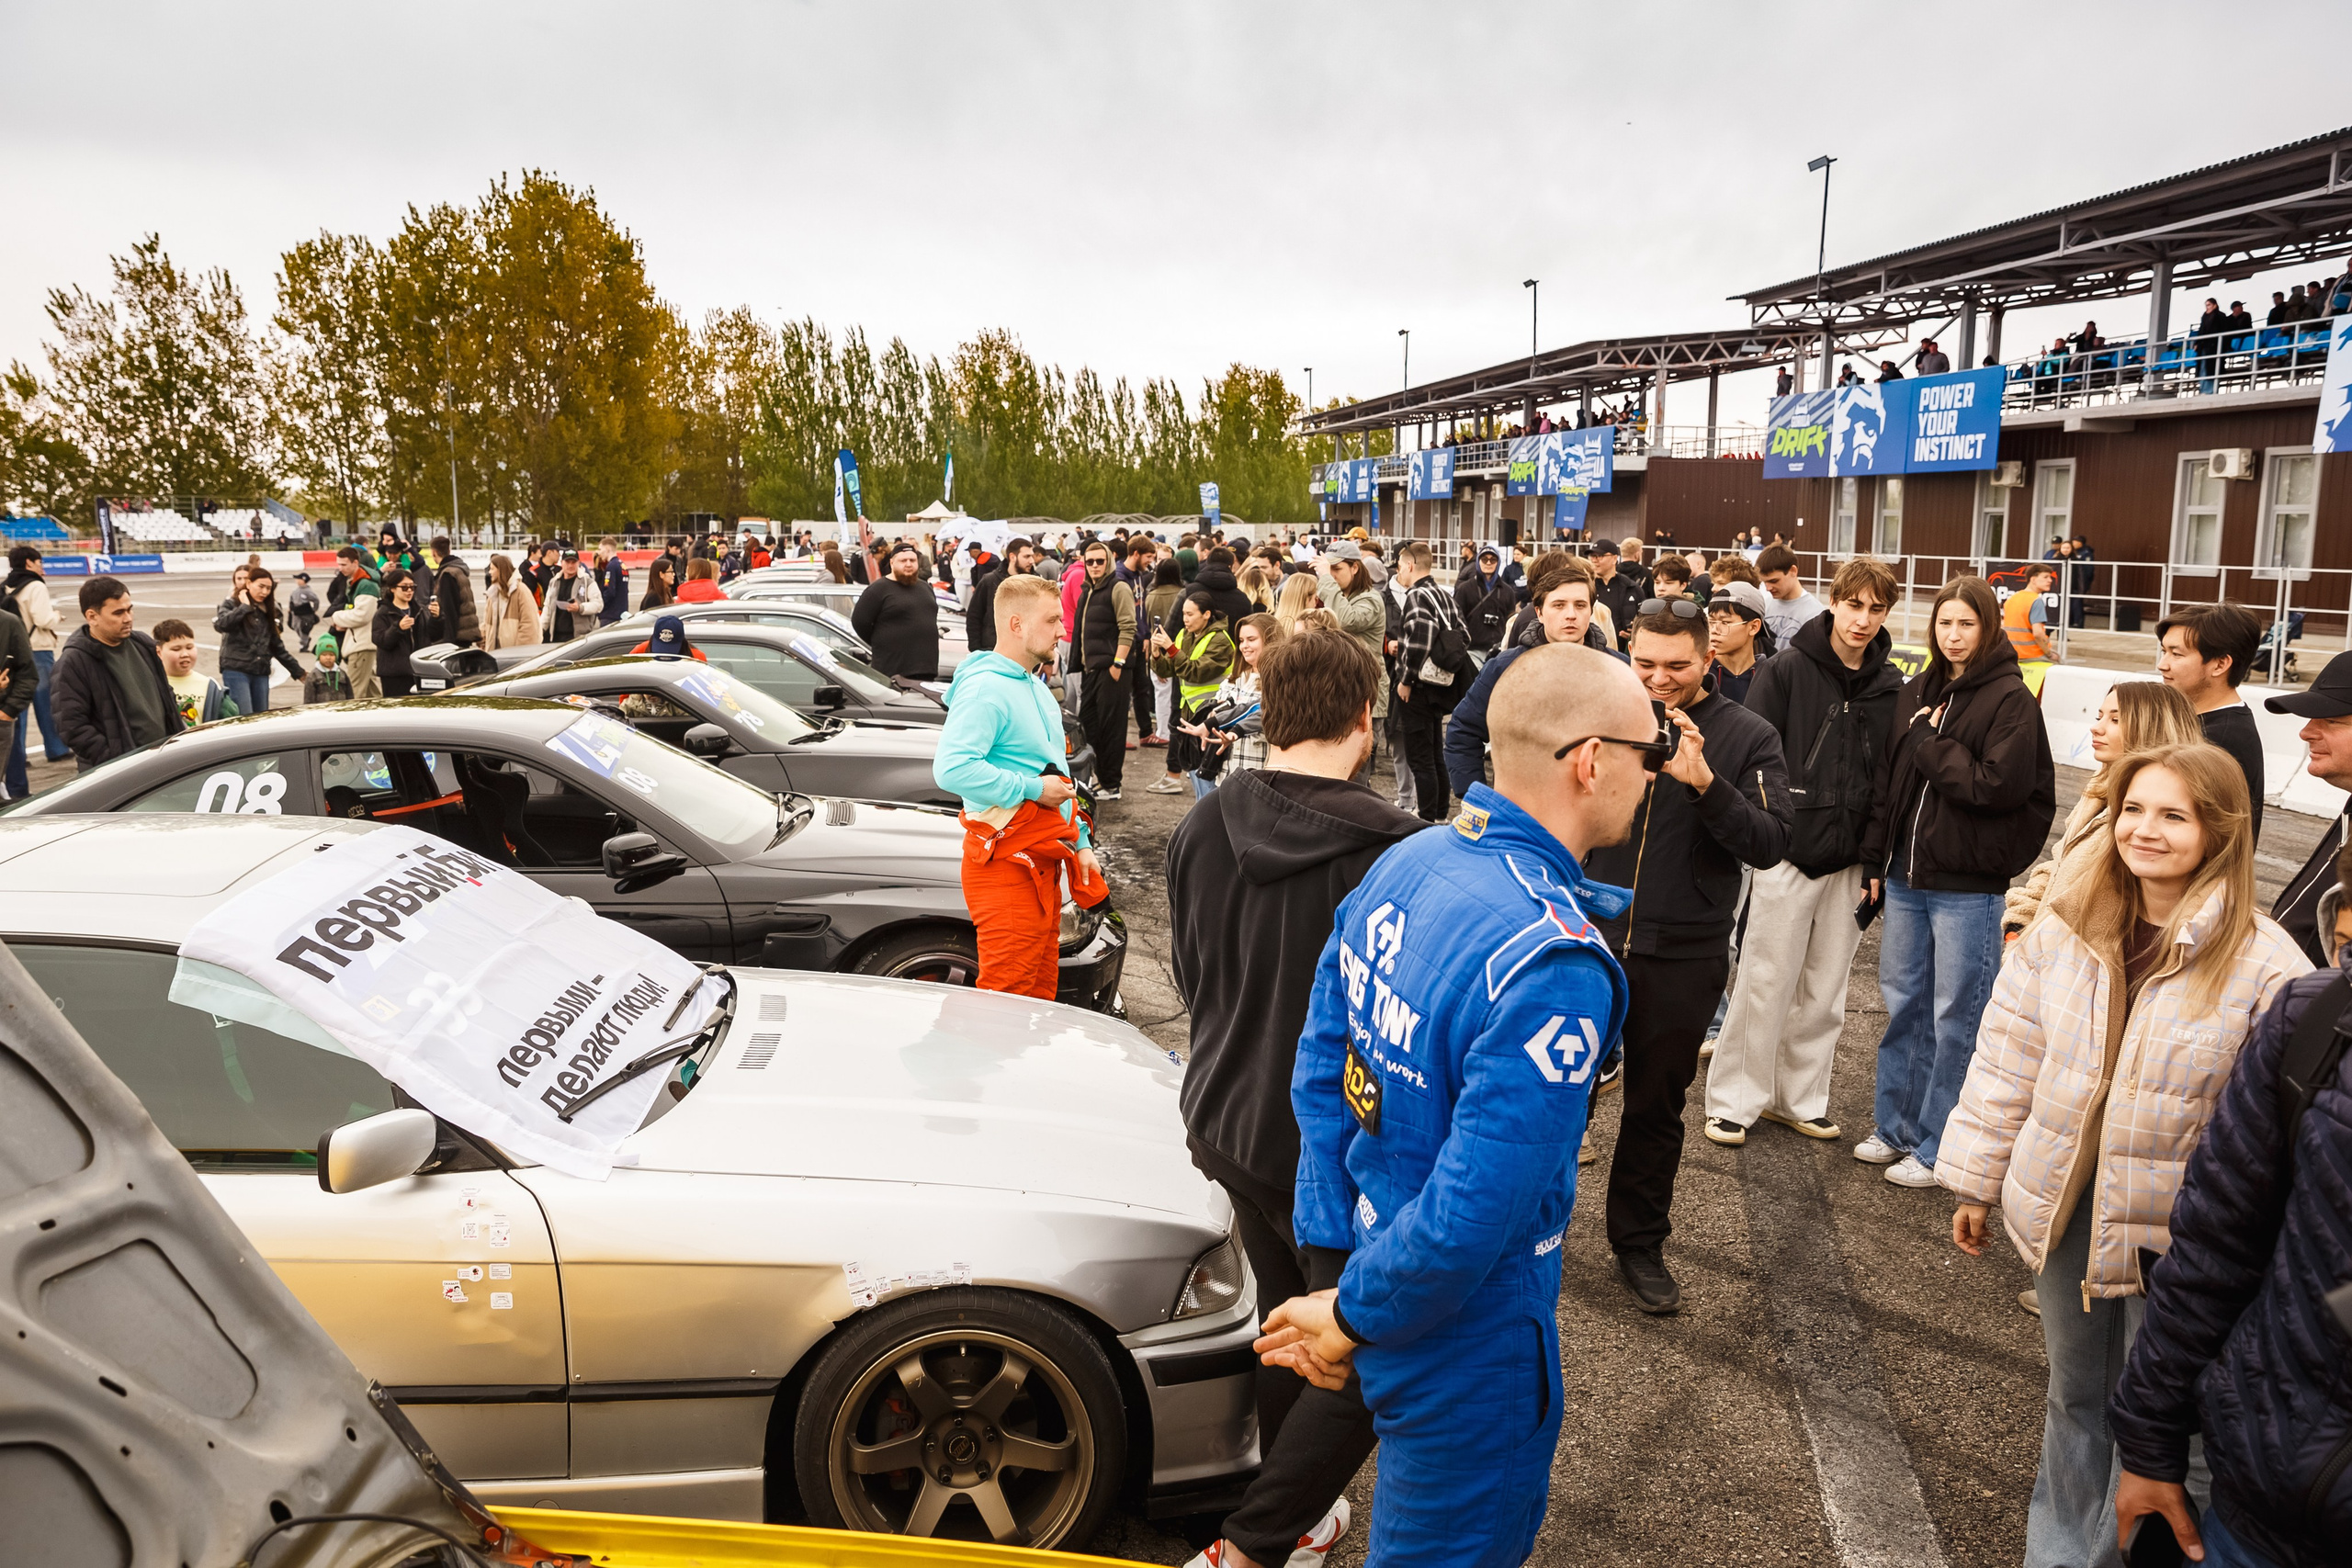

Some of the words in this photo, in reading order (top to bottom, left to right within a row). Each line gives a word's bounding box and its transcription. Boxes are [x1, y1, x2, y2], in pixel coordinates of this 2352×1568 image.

[1918, 381, 1975, 412] POWER
[1917, 410, 1959, 436] YOUR
[1770, 424, 1827, 458] DRIFT
[1914, 433, 1986, 462] INSTINCT
[733, 709, 764, 733] 78
[194, 771, 288, 815] 08
[617, 767, 658, 794] 08
[496, 980, 603, 1089] первыми
[540, 1012, 628, 1124] делают
[611, 973, 670, 1026] люди!
[1348, 1010, 1372, 1050] Enjoy
[1386, 1059, 1427, 1089] work
